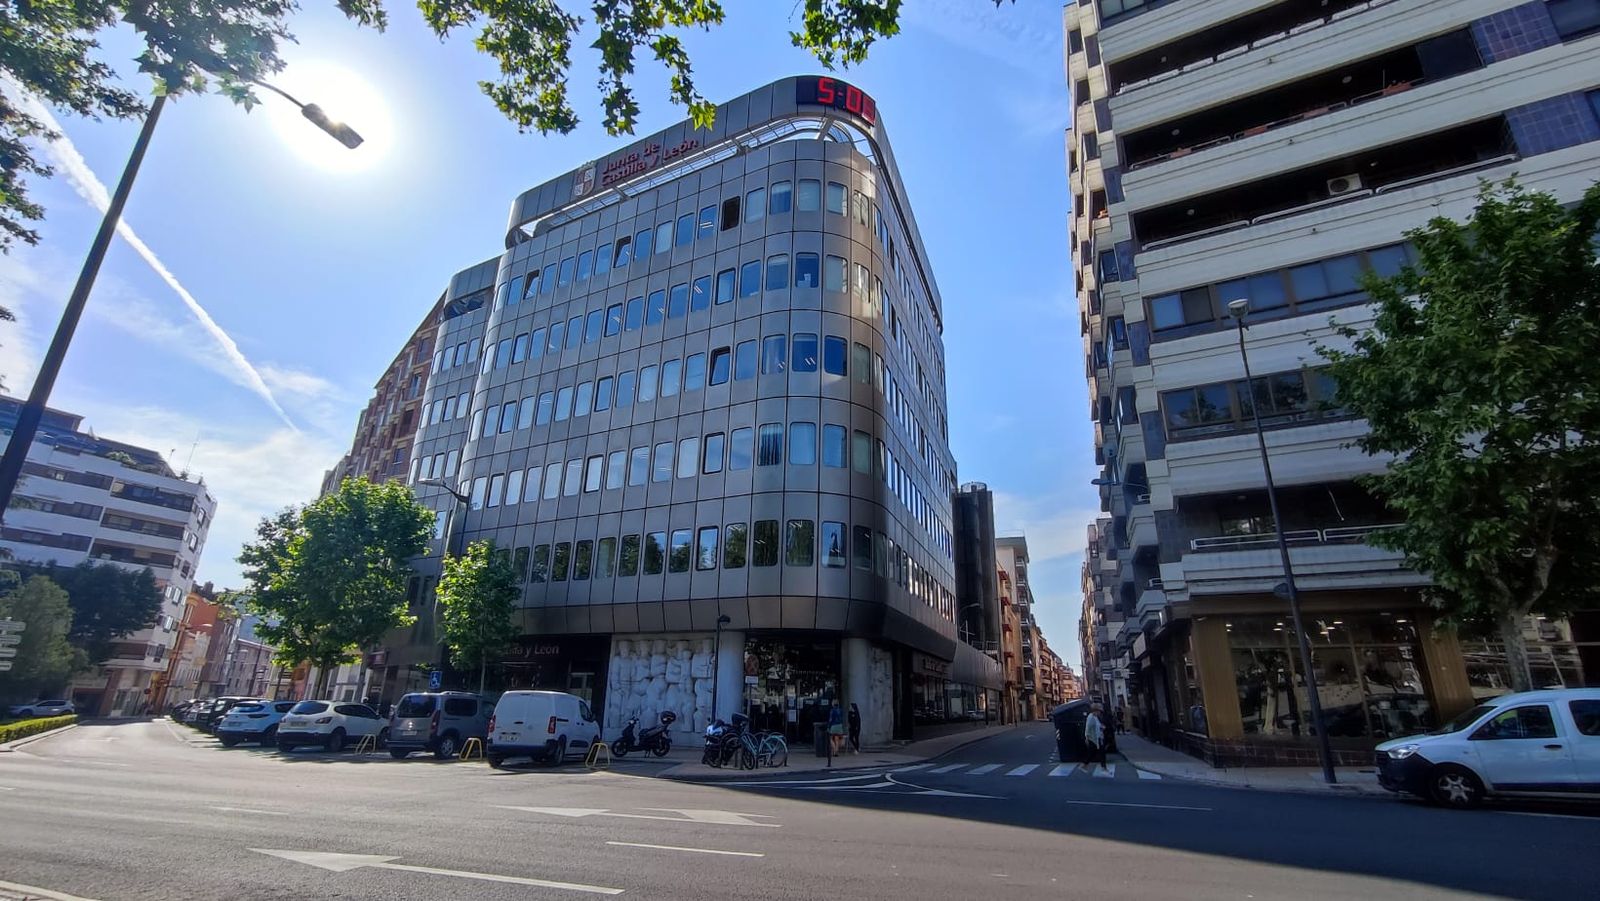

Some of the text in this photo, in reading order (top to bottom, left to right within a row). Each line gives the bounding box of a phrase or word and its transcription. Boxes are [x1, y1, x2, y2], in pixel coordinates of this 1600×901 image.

[601, 138, 699, 186] Castilla y León
[603, 142, 660, 175] Junta de
[524, 647, 532, 658] y
